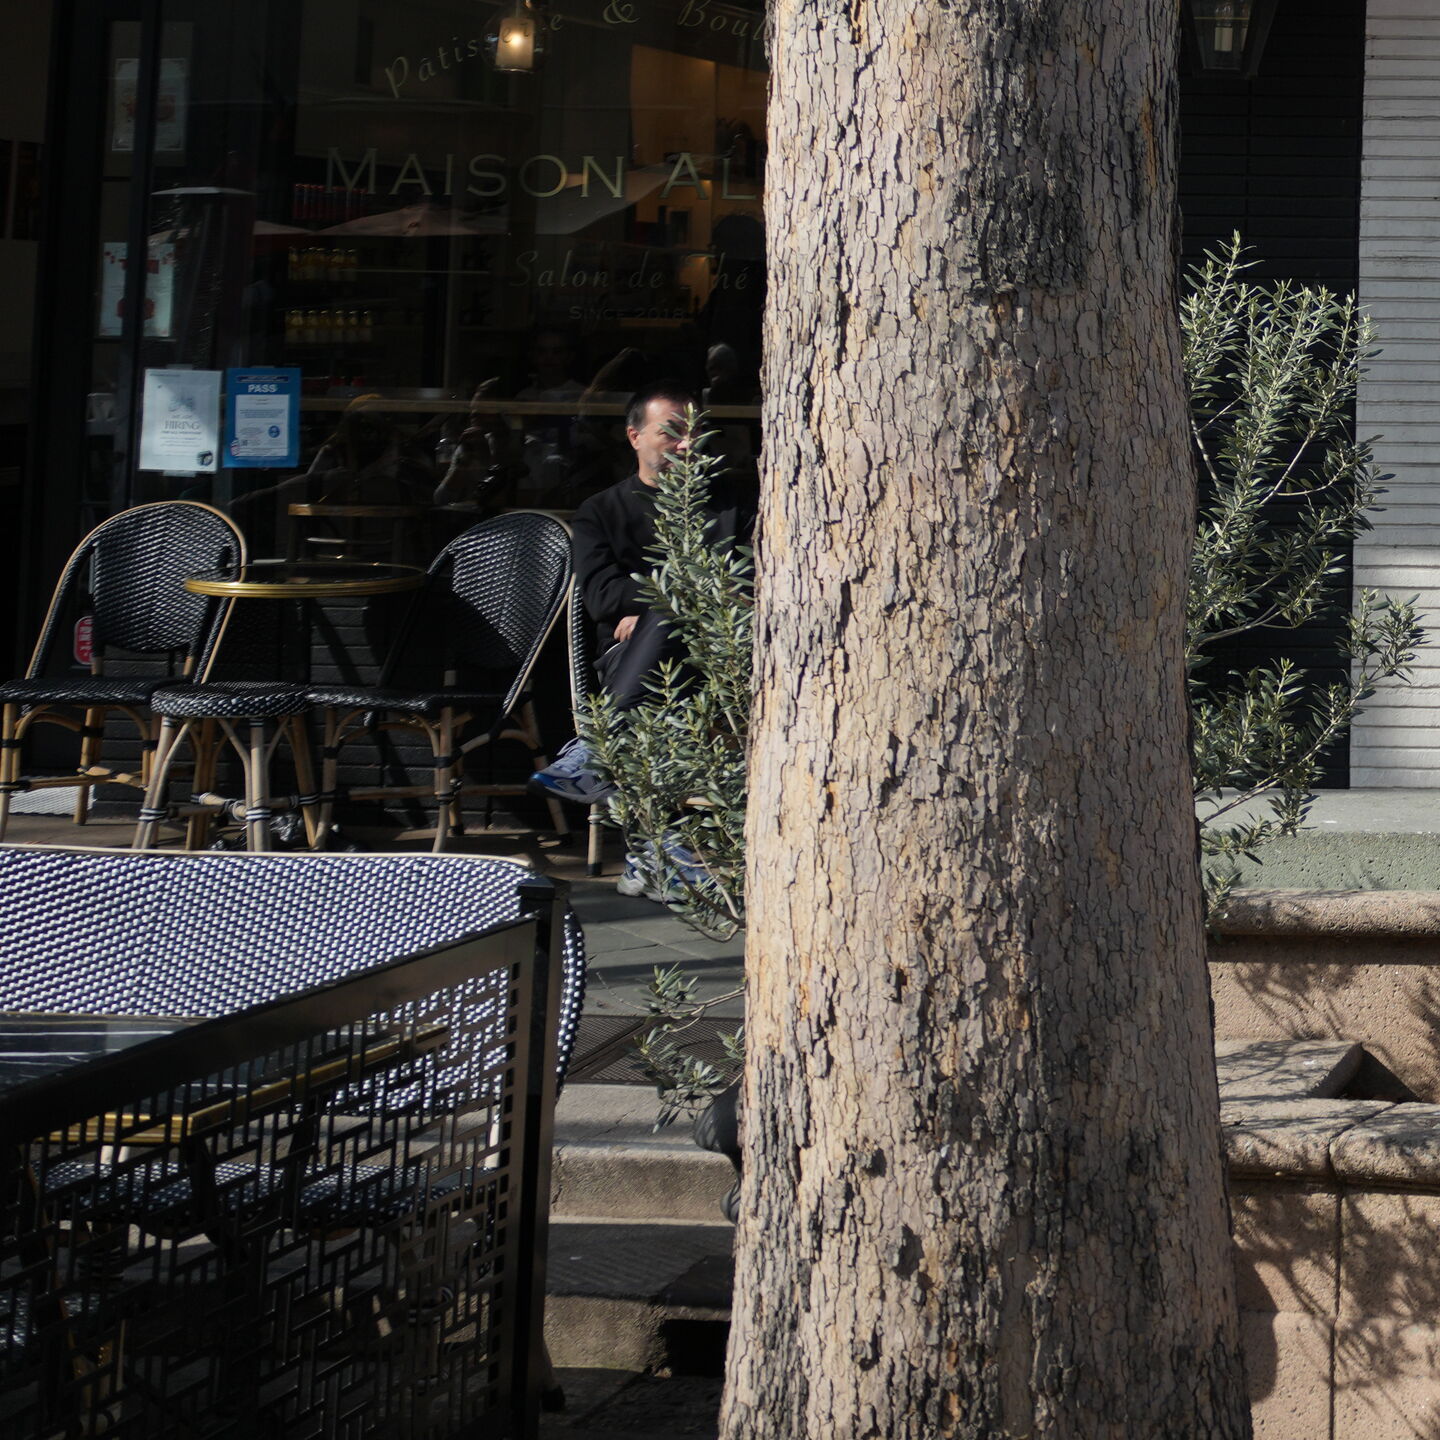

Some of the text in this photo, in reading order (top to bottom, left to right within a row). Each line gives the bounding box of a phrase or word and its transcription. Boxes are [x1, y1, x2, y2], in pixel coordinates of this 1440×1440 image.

[325, 147, 627, 199] MAISON
[509, 249, 610, 289] Salon
[626, 250, 666, 290] de
[247, 383, 279, 394] PASS
[164, 420, 200, 430] HIRING
